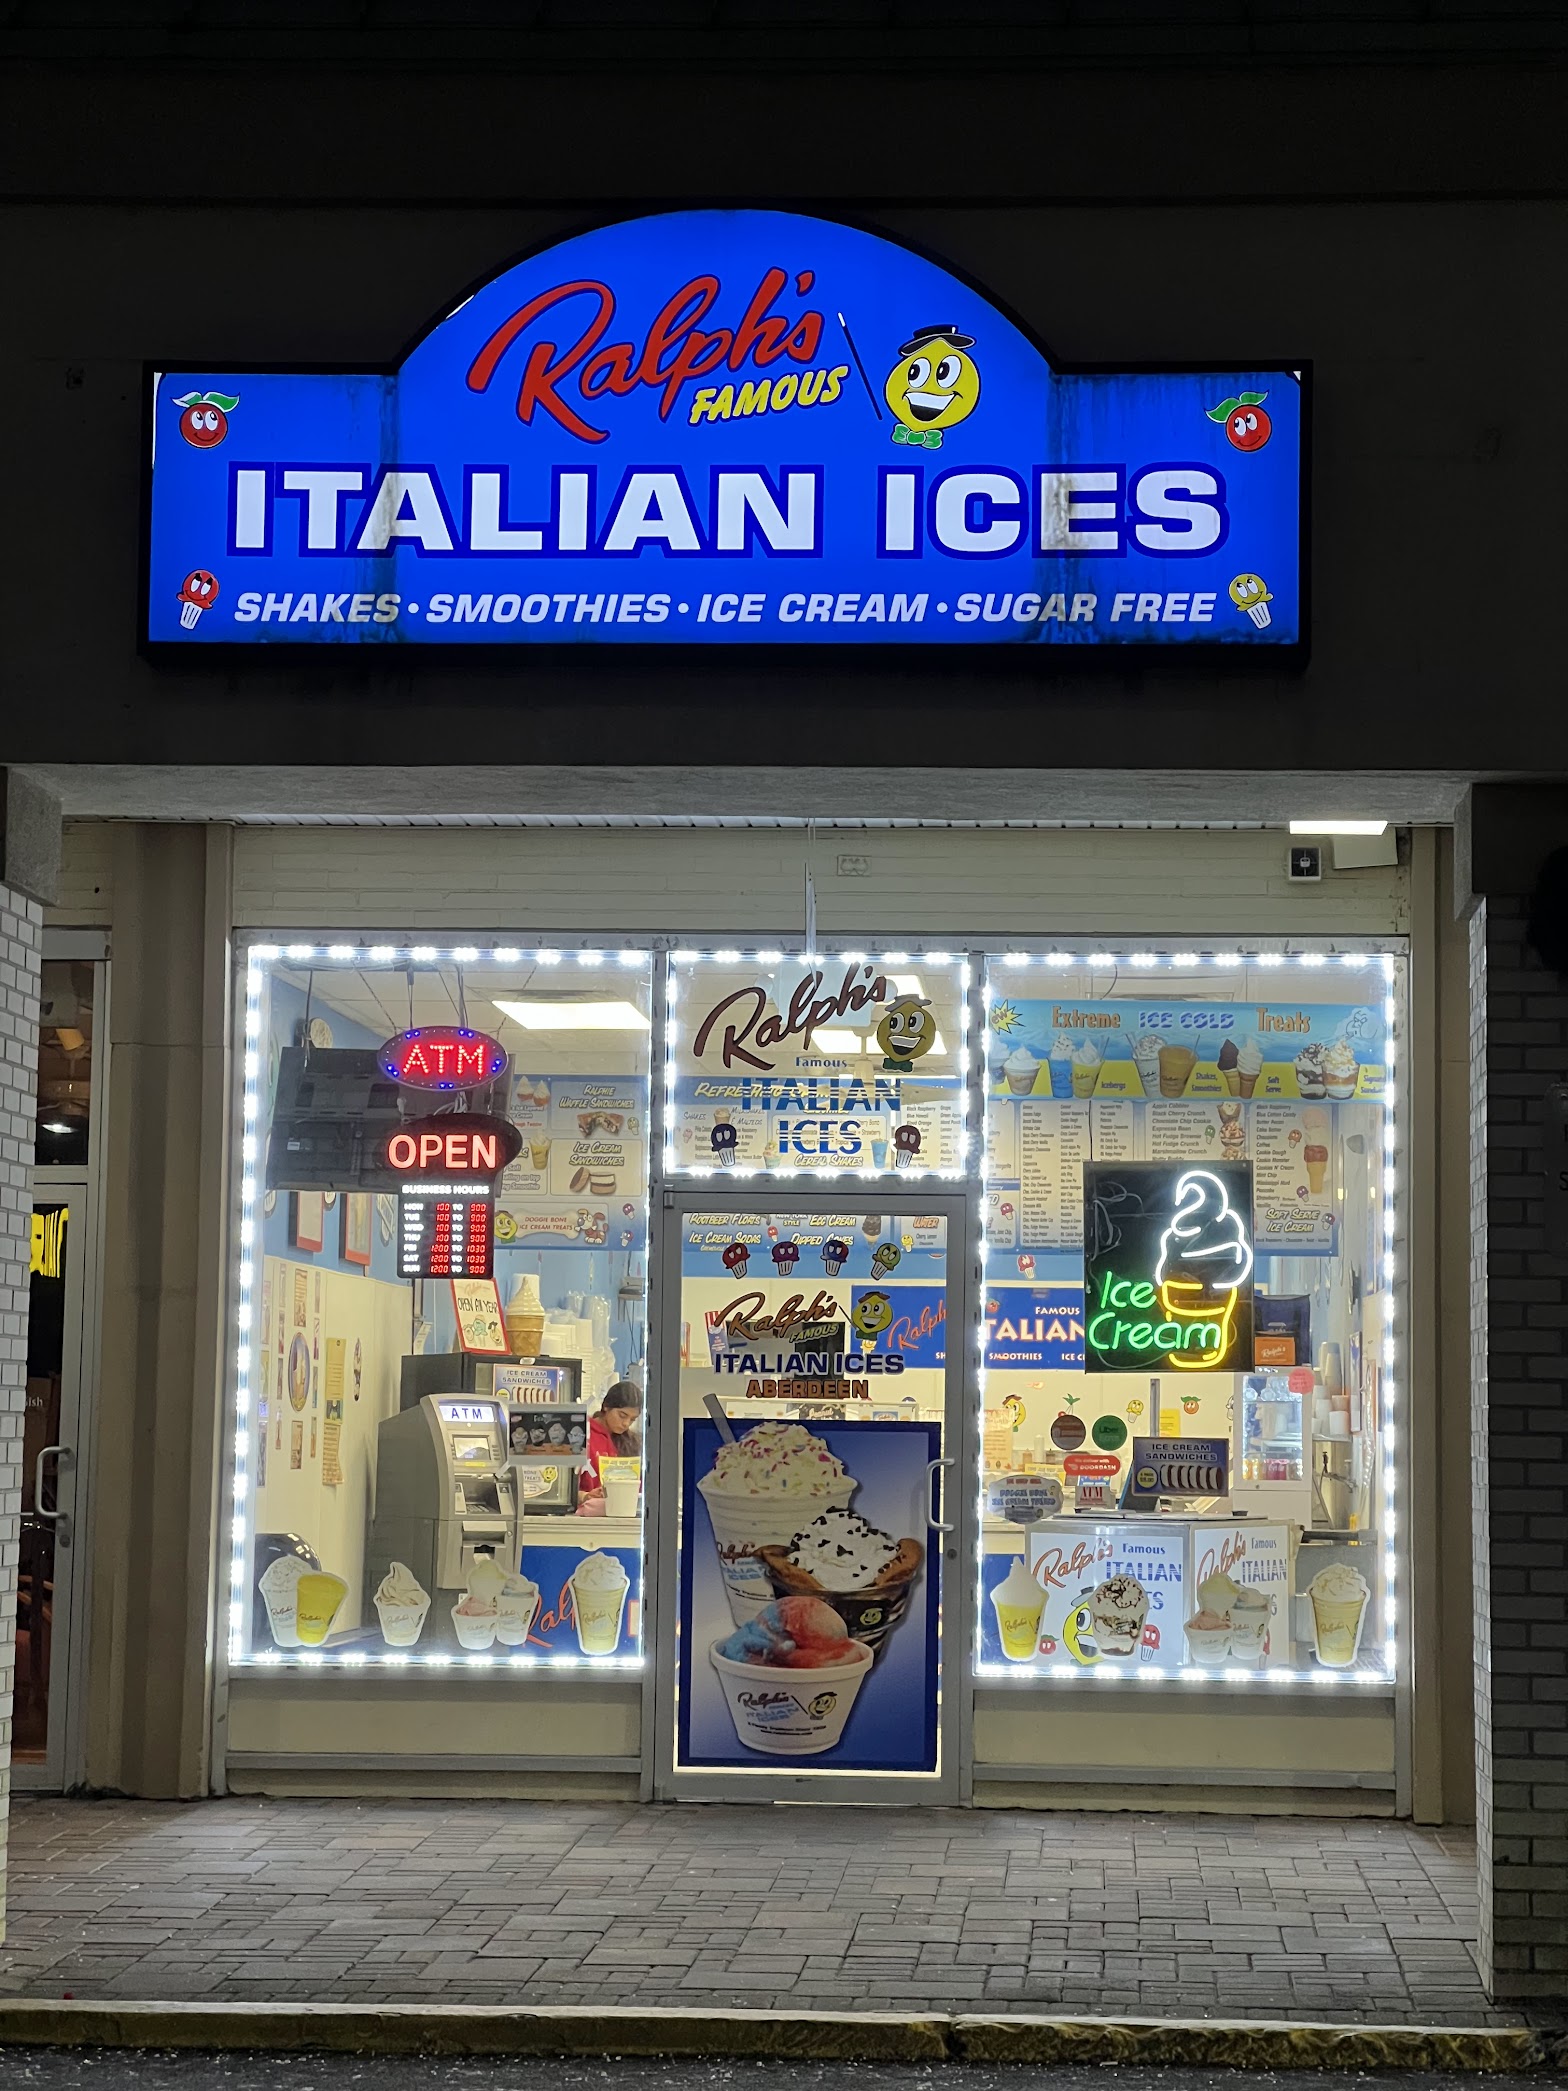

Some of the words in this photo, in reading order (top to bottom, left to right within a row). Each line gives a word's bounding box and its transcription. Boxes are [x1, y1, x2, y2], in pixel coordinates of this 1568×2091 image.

[466, 268, 822, 444] Ralph's
[689, 365, 849, 425] FAMOUS
[234, 468, 817, 552] ITALIAN
[884, 468, 1223, 552] ICES
[234, 592, 401, 624] SHAKES
[425, 593, 670, 624] SMOOTHIES
[696, 593, 766, 623] ICE
[777, 593, 926, 623] CREAM
[954, 592, 1097, 623] SUGAR
[1110, 592, 1216, 622] FREE
[693, 963, 887, 1070] Ralph's
[1051, 1005, 1121, 1029] Extreme
[1138, 1011, 1173, 1030] ICE
[1180, 1011, 1236, 1031] COLD
[1256, 1007, 1311, 1034] Treats
[402, 1044, 484, 1074] ATM
[795, 1056, 848, 1069] Famous
[742, 1077, 901, 1111] ITALIAN
[590, 1097, 635, 1110] SANDWICHES
[779, 1119, 863, 1155] ICES
[388, 1134, 496, 1169] OPEN
[572, 1142, 586, 1154] ICE
[591, 1142, 622, 1154] CREAM
[568, 1155, 625, 1167] SANDWICHES
[794, 1154, 827, 1167] CEREAL
[829, 1154, 864, 1167] SHAKES
[453, 1185, 490, 1195] HOURS
[690, 1213, 729, 1226] ROOTBEER
[732, 1213, 761, 1226] FLOATS
[1265, 1207, 1290, 1220] SOFT
[1290, 1207, 1321, 1220] SERVE
[828, 1215, 857, 1227] CREAM
[1266, 1220, 1284, 1233] ICE
[1284, 1220, 1315, 1233] CREAM
[689, 1232, 704, 1244] ICE
[705, 1232, 733, 1244] CREAM
[734, 1232, 762, 1244] SODAS
[790, 1233, 823, 1246] DIPPED
[1100, 1270, 1157, 1309] Ice
[714, 1290, 838, 1341] Ralph's
[1035, 1307, 1080, 1315] FAMOUS
[788, 1322, 839, 1344] FAMOUS
[1088, 1311, 1223, 1350] Cream
[988, 1352, 1043, 1361] SMOOTHIES
[1061, 1353, 1078, 1361] ICE
[714, 1353, 828, 1374] ITALIAN
[835, 1353, 906, 1374] ICES
[502, 1377, 552, 1385] SANDWICHES
[746, 1379, 869, 1399] ABERDEEN
[451, 1407, 483, 1420] ATM
[1152, 1443, 1169, 1451] ICE
[1172, 1443, 1211, 1452] CREAM
[1145, 1452, 1218, 1461] SANDWICHES
[1122, 1542, 1166, 1555] Famous
[1251, 1537, 1277, 1549] Famous
[1033, 1537, 1114, 1588] Ralph's
[1105, 1561, 1183, 1583] ITALIAN
[1242, 1558, 1287, 1584] ITALIAN
